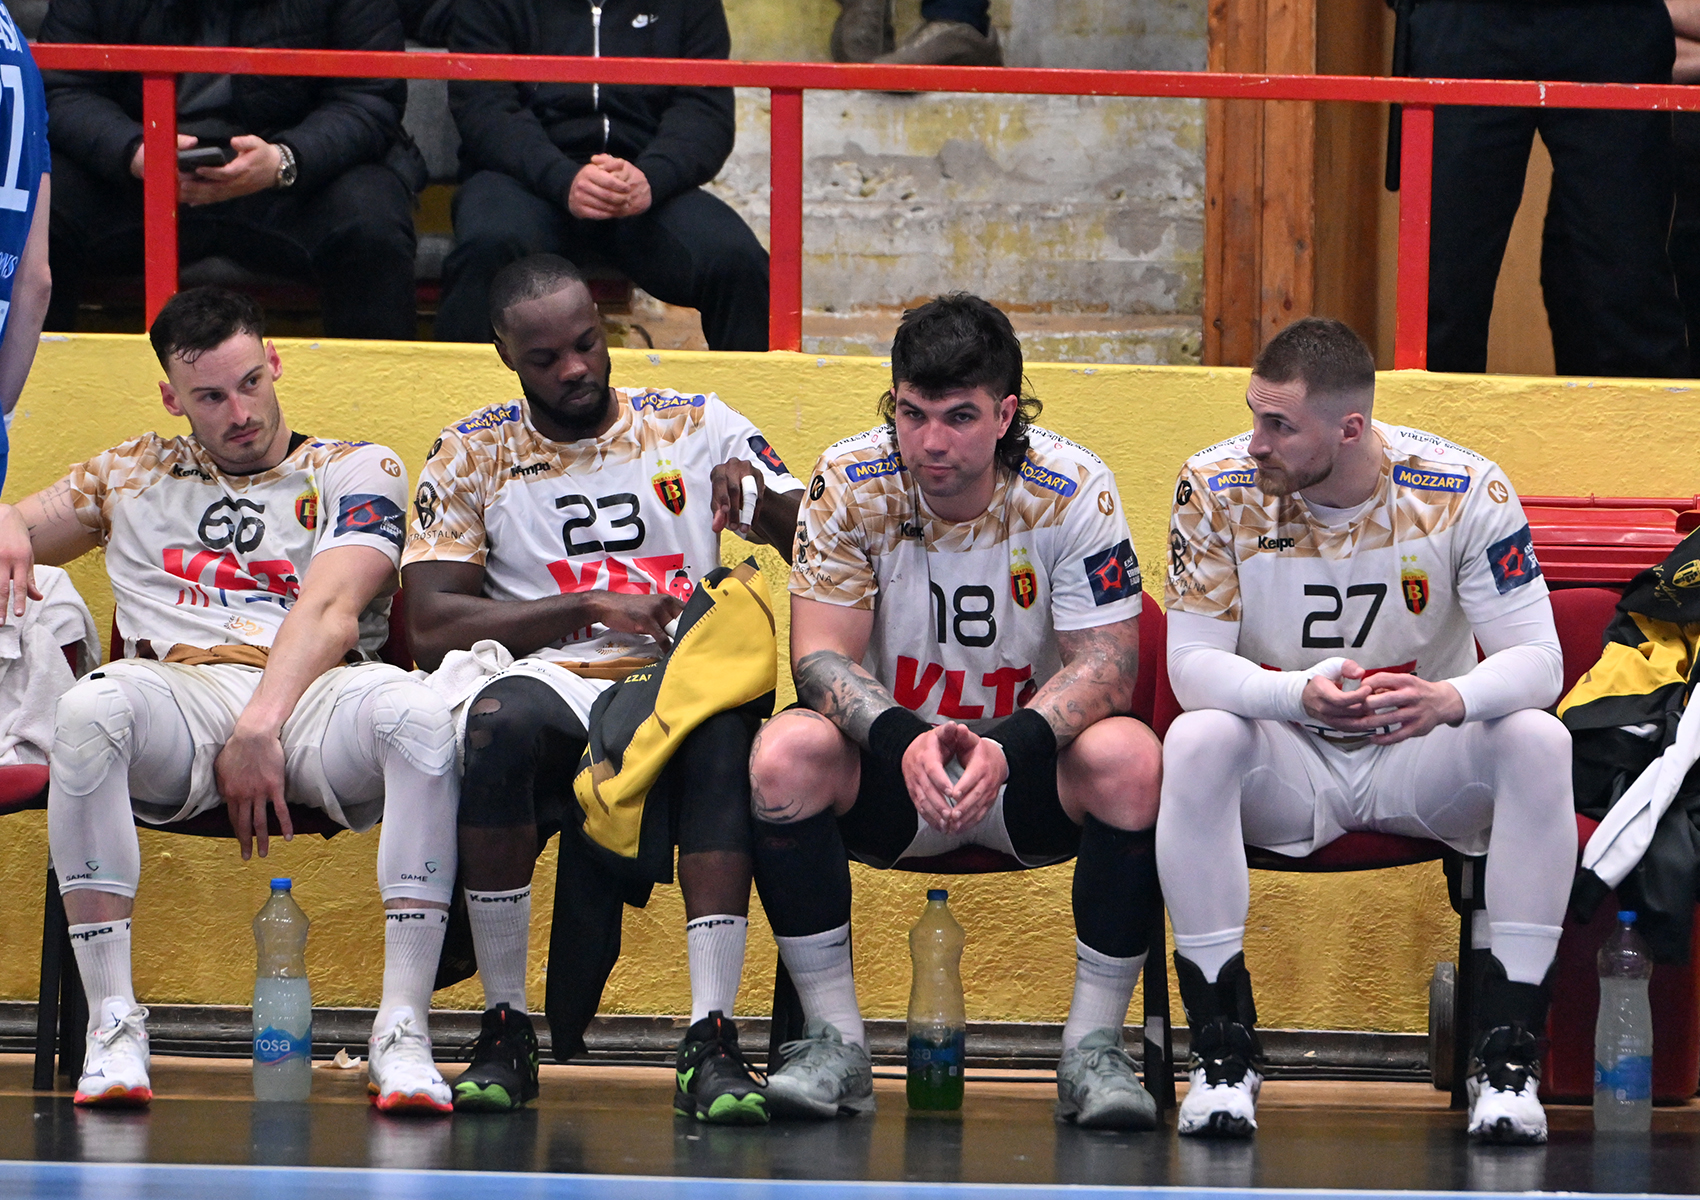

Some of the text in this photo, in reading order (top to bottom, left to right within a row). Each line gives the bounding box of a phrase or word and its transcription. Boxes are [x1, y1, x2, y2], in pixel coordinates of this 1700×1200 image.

[1217, 472, 1254, 487] MOZZ
[1399, 470, 1465, 489] MOZZART
[198, 496, 265, 555] 66
[555, 493, 646, 557] 23
[930, 580, 997, 648] 18
[1301, 583, 1388, 648] 27
[894, 655, 1032, 719] VLT
[400, 873, 429, 882] GAME
[470, 890, 531, 904] Kempa
[256, 1039, 290, 1052] rosa
